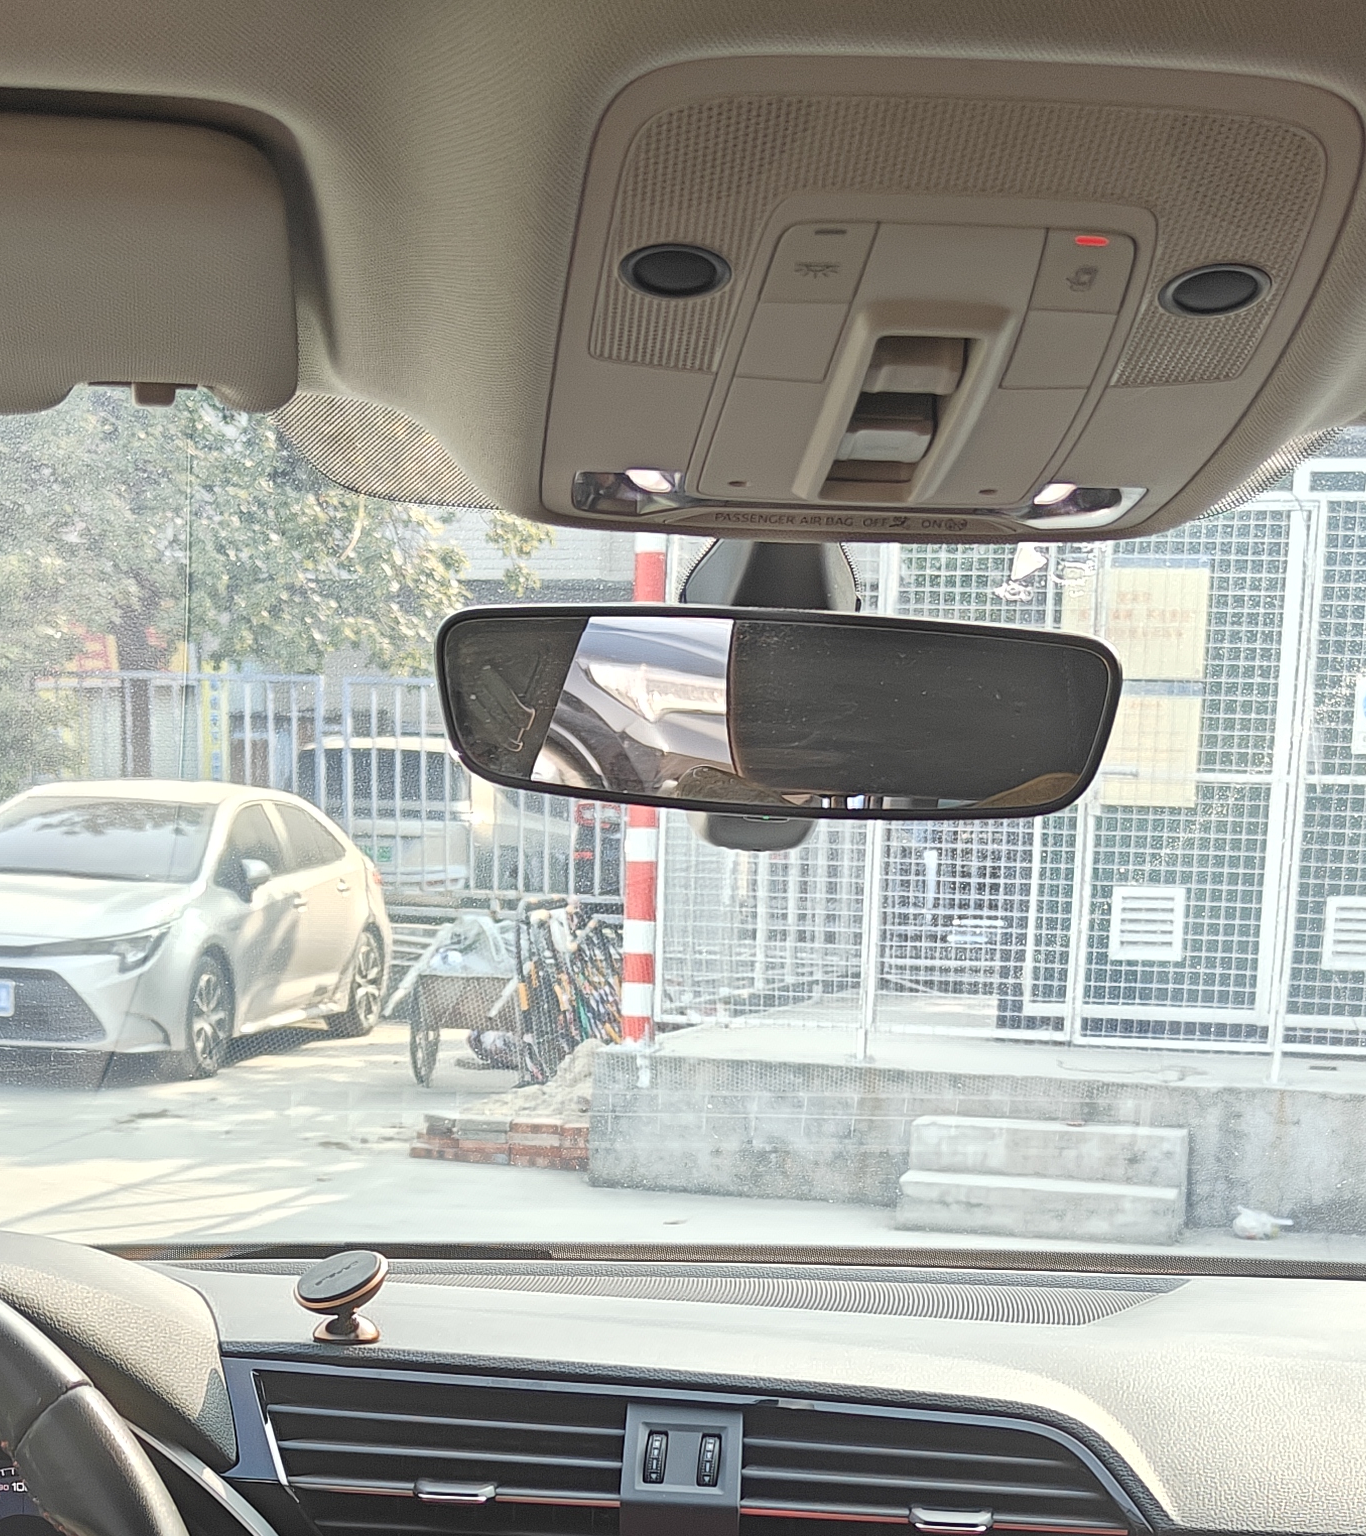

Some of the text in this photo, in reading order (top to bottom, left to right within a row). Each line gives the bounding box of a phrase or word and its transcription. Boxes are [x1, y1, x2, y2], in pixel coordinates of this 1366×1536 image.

[714, 512, 795, 525] PASSENGER
[863, 518, 887, 528] OFF
[921, 519, 943, 530] ON
[12, 1482, 28, 1492] 10
